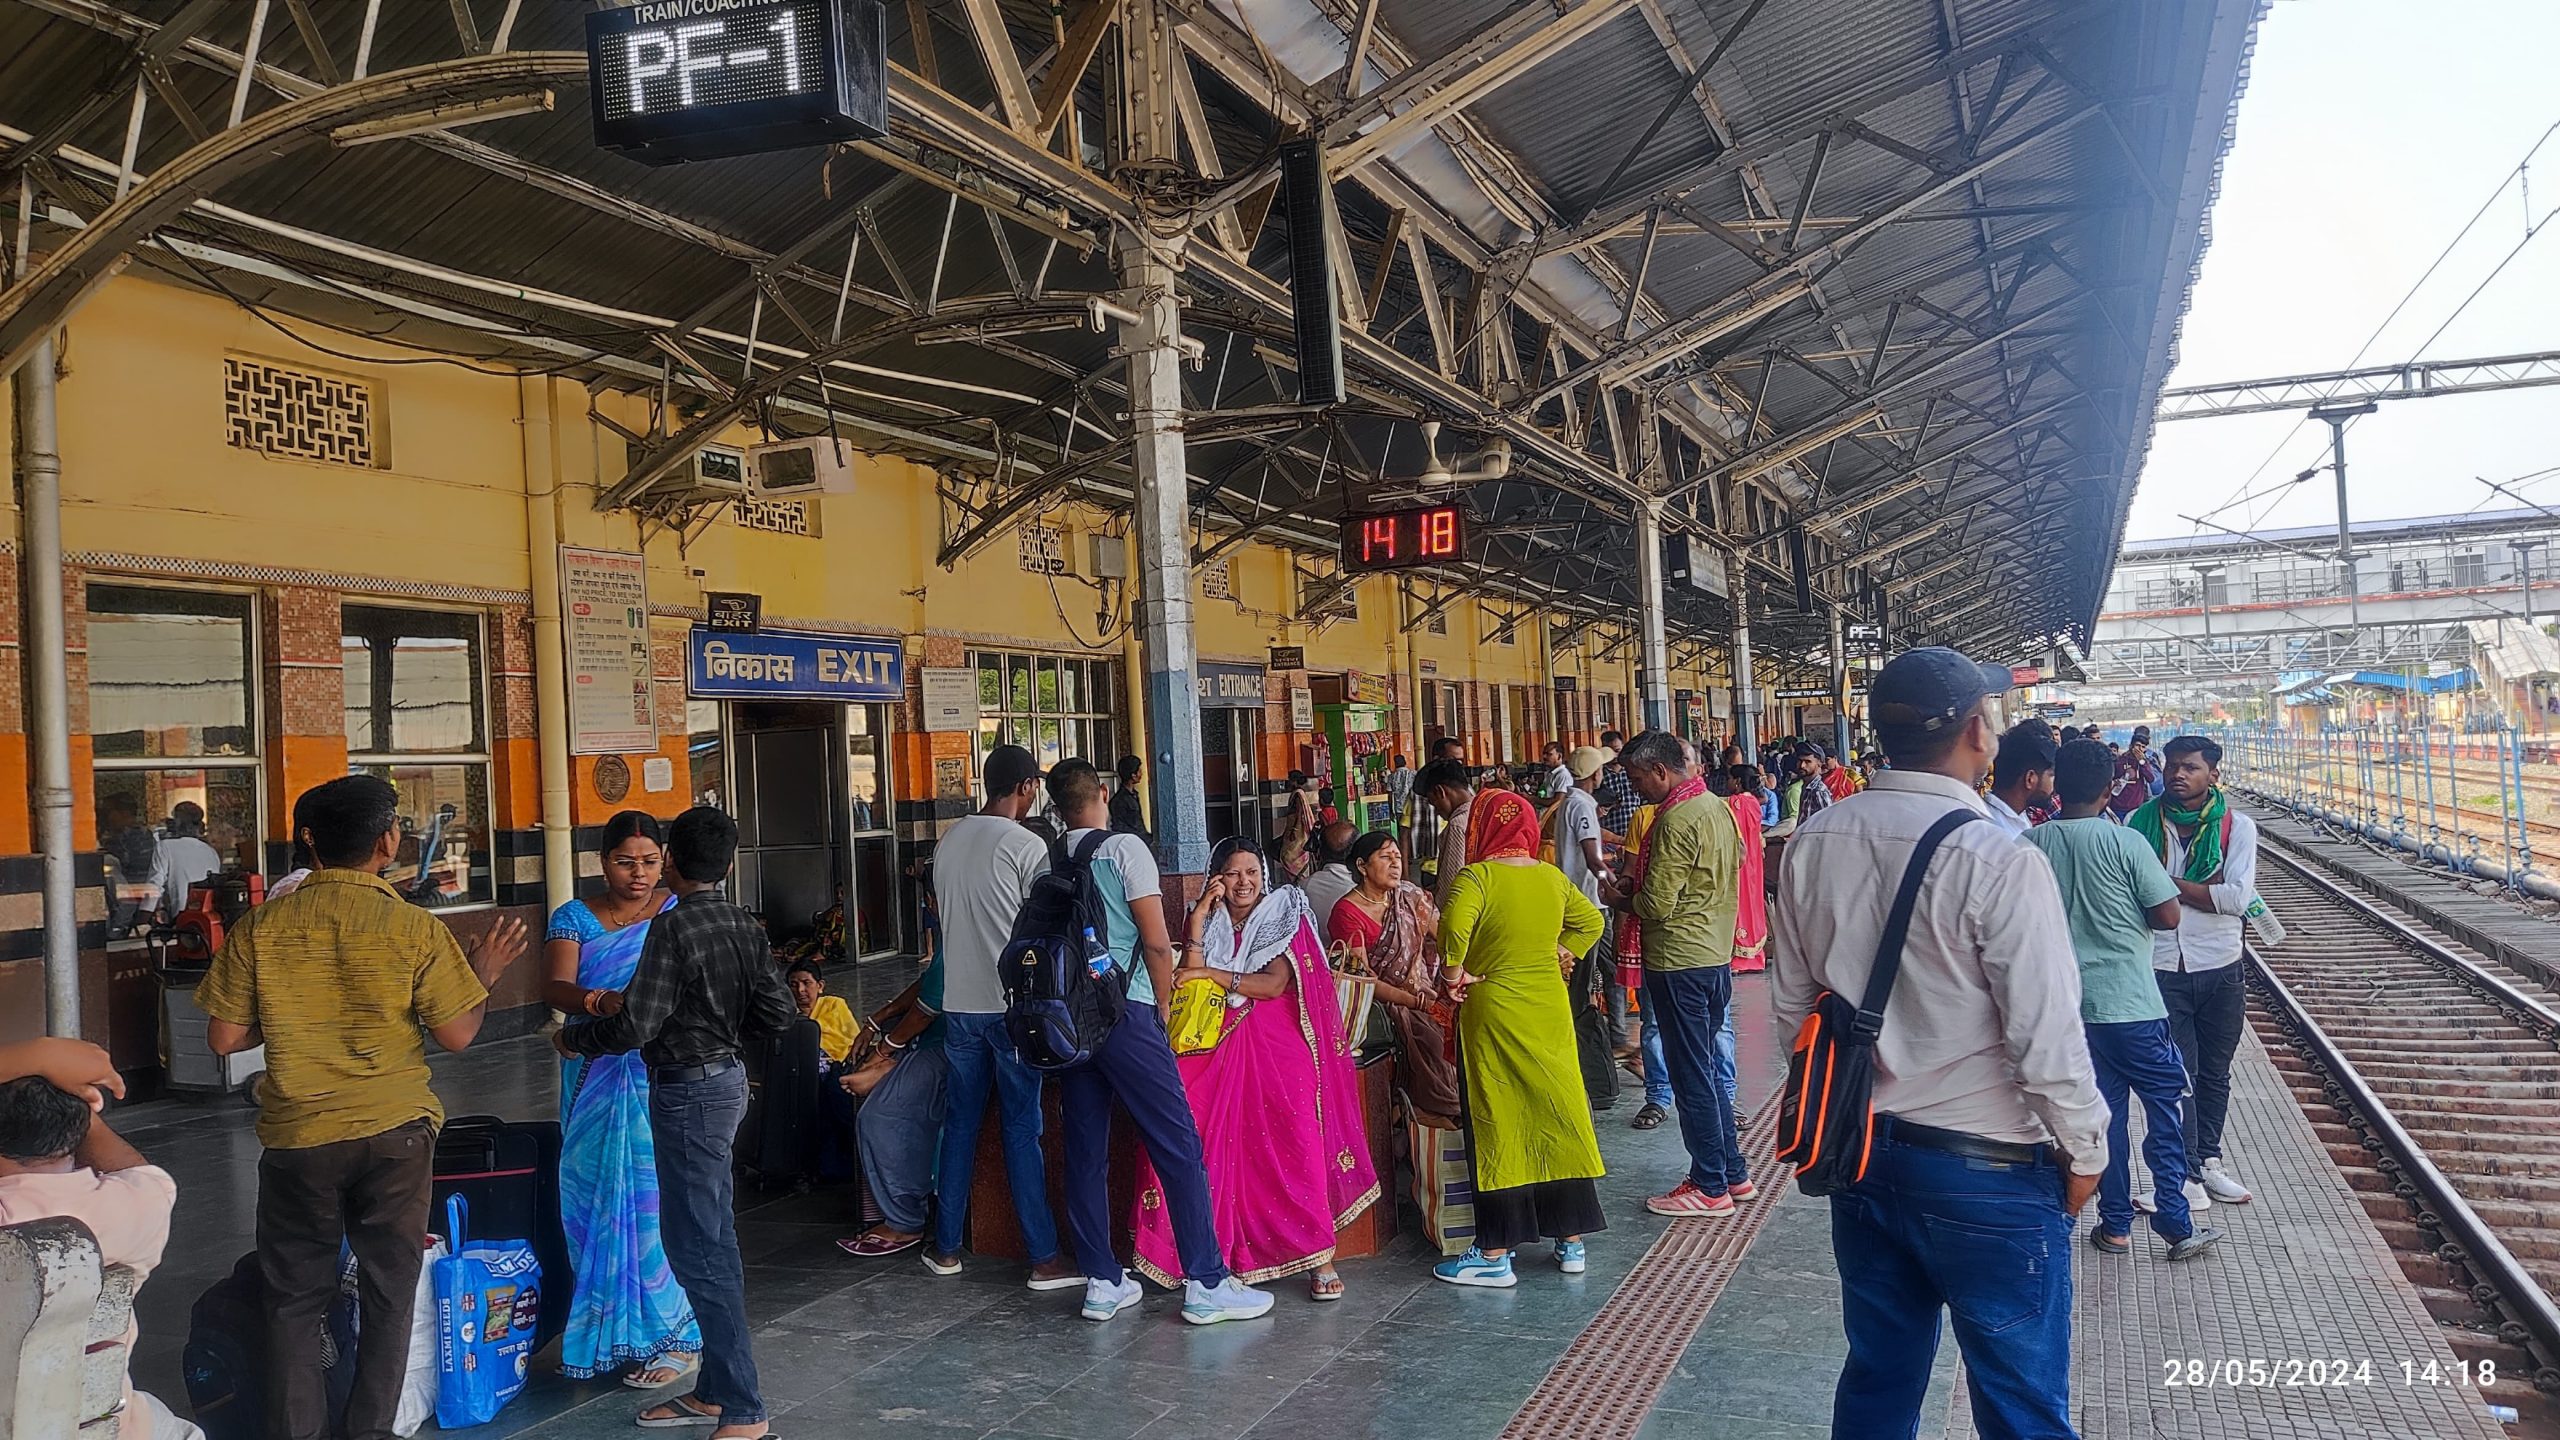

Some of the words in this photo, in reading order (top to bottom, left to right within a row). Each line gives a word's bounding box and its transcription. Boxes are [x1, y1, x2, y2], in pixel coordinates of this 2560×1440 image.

[626, 10, 799, 112] PF-1
[1363, 518, 1396, 562] 14
[1420, 511, 1454, 557] 18
[711, 619, 753, 628] EXIT
[713, 610, 753, 621] बाहर
[1850, 626, 1882, 639] PF-1
[703, 640, 795, 682] निकास
[816, 648, 894, 685] EXIT
[1218, 674, 1262, 698] ENTRANCE
[442, 1298, 452, 1334] SEEDS
[444, 1335, 454, 1373] LAXMI
